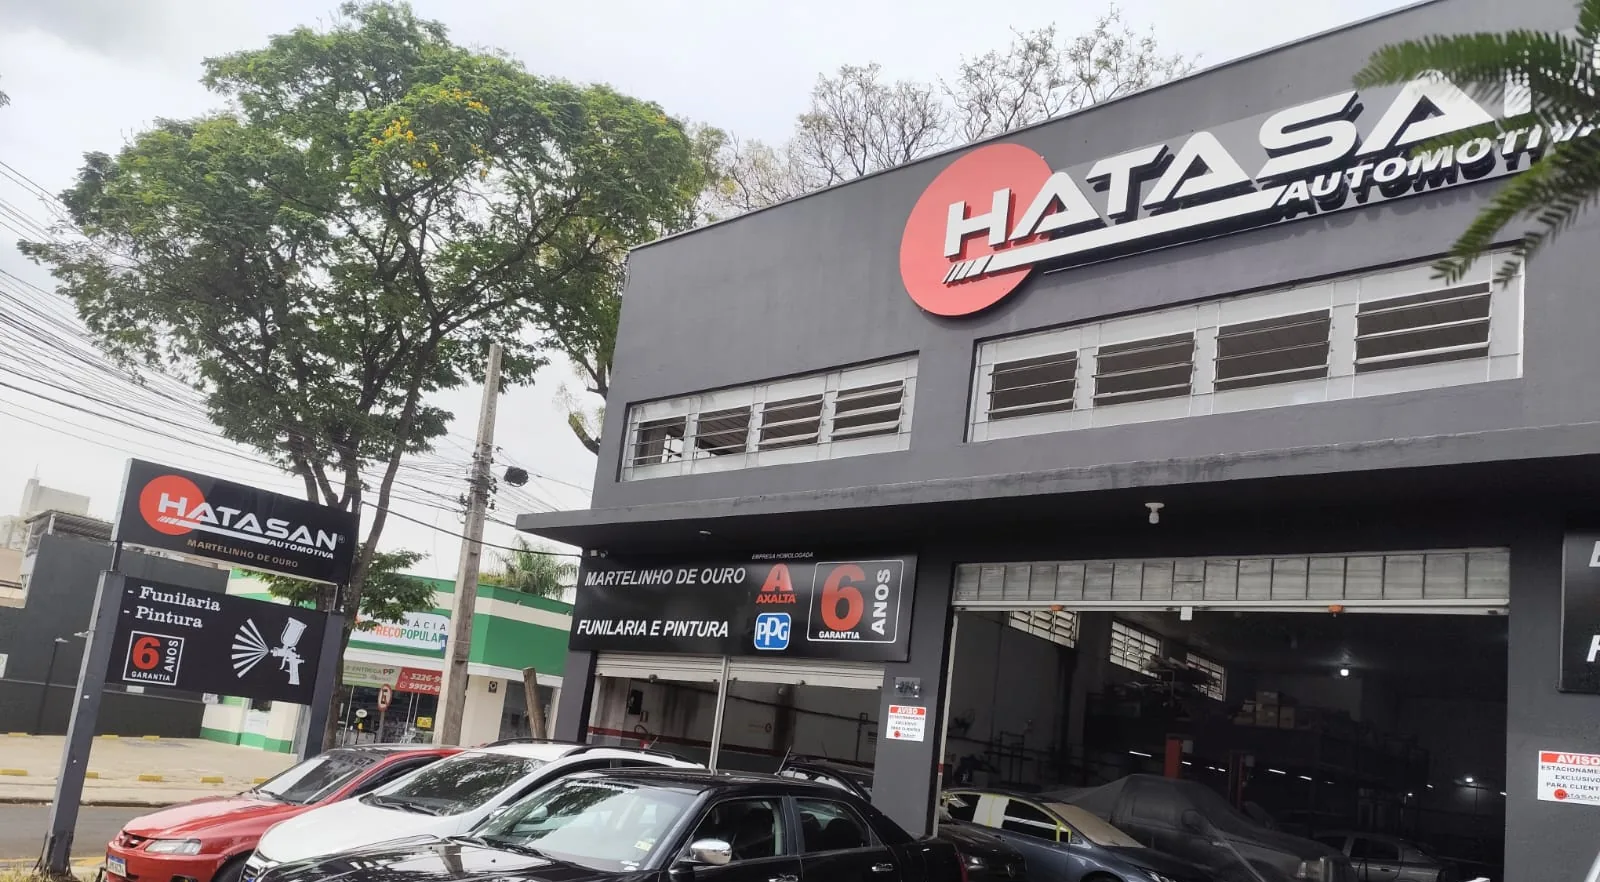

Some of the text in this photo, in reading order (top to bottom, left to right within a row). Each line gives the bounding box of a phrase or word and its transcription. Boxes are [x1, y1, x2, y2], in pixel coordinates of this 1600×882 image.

[943, 68, 1532, 258] HATASA
[1278, 112, 1600, 206] AUTOMOTIV
[158, 492, 337, 551] HATASAN
[186, 539, 299, 568] MARTELINHO DE OURO
[268, 539, 334, 560] AUTOMOTIVA
[585, 567, 746, 586] MARTELINHO DE OURO
[139, 586, 221, 611] Funilaria
[755, 593, 797, 603] AXALTA
[821, 563, 866, 631] 6
[871, 568, 891, 636] ANOS
[135, 605, 203, 628] Pintura
[576, 619, 729, 638] FUNILARIA E PINTURA
[757, 617, 788, 646] PPG
[818, 631, 860, 640] GARANTIA
[132, 636, 160, 670] 6
[164, 640, 179, 672] ANOS
[131, 671, 170, 681] GARANTIA
[1556, 754, 1600, 765] AVISO
[1555, 775, 1600, 783] EXCLUSIVO
